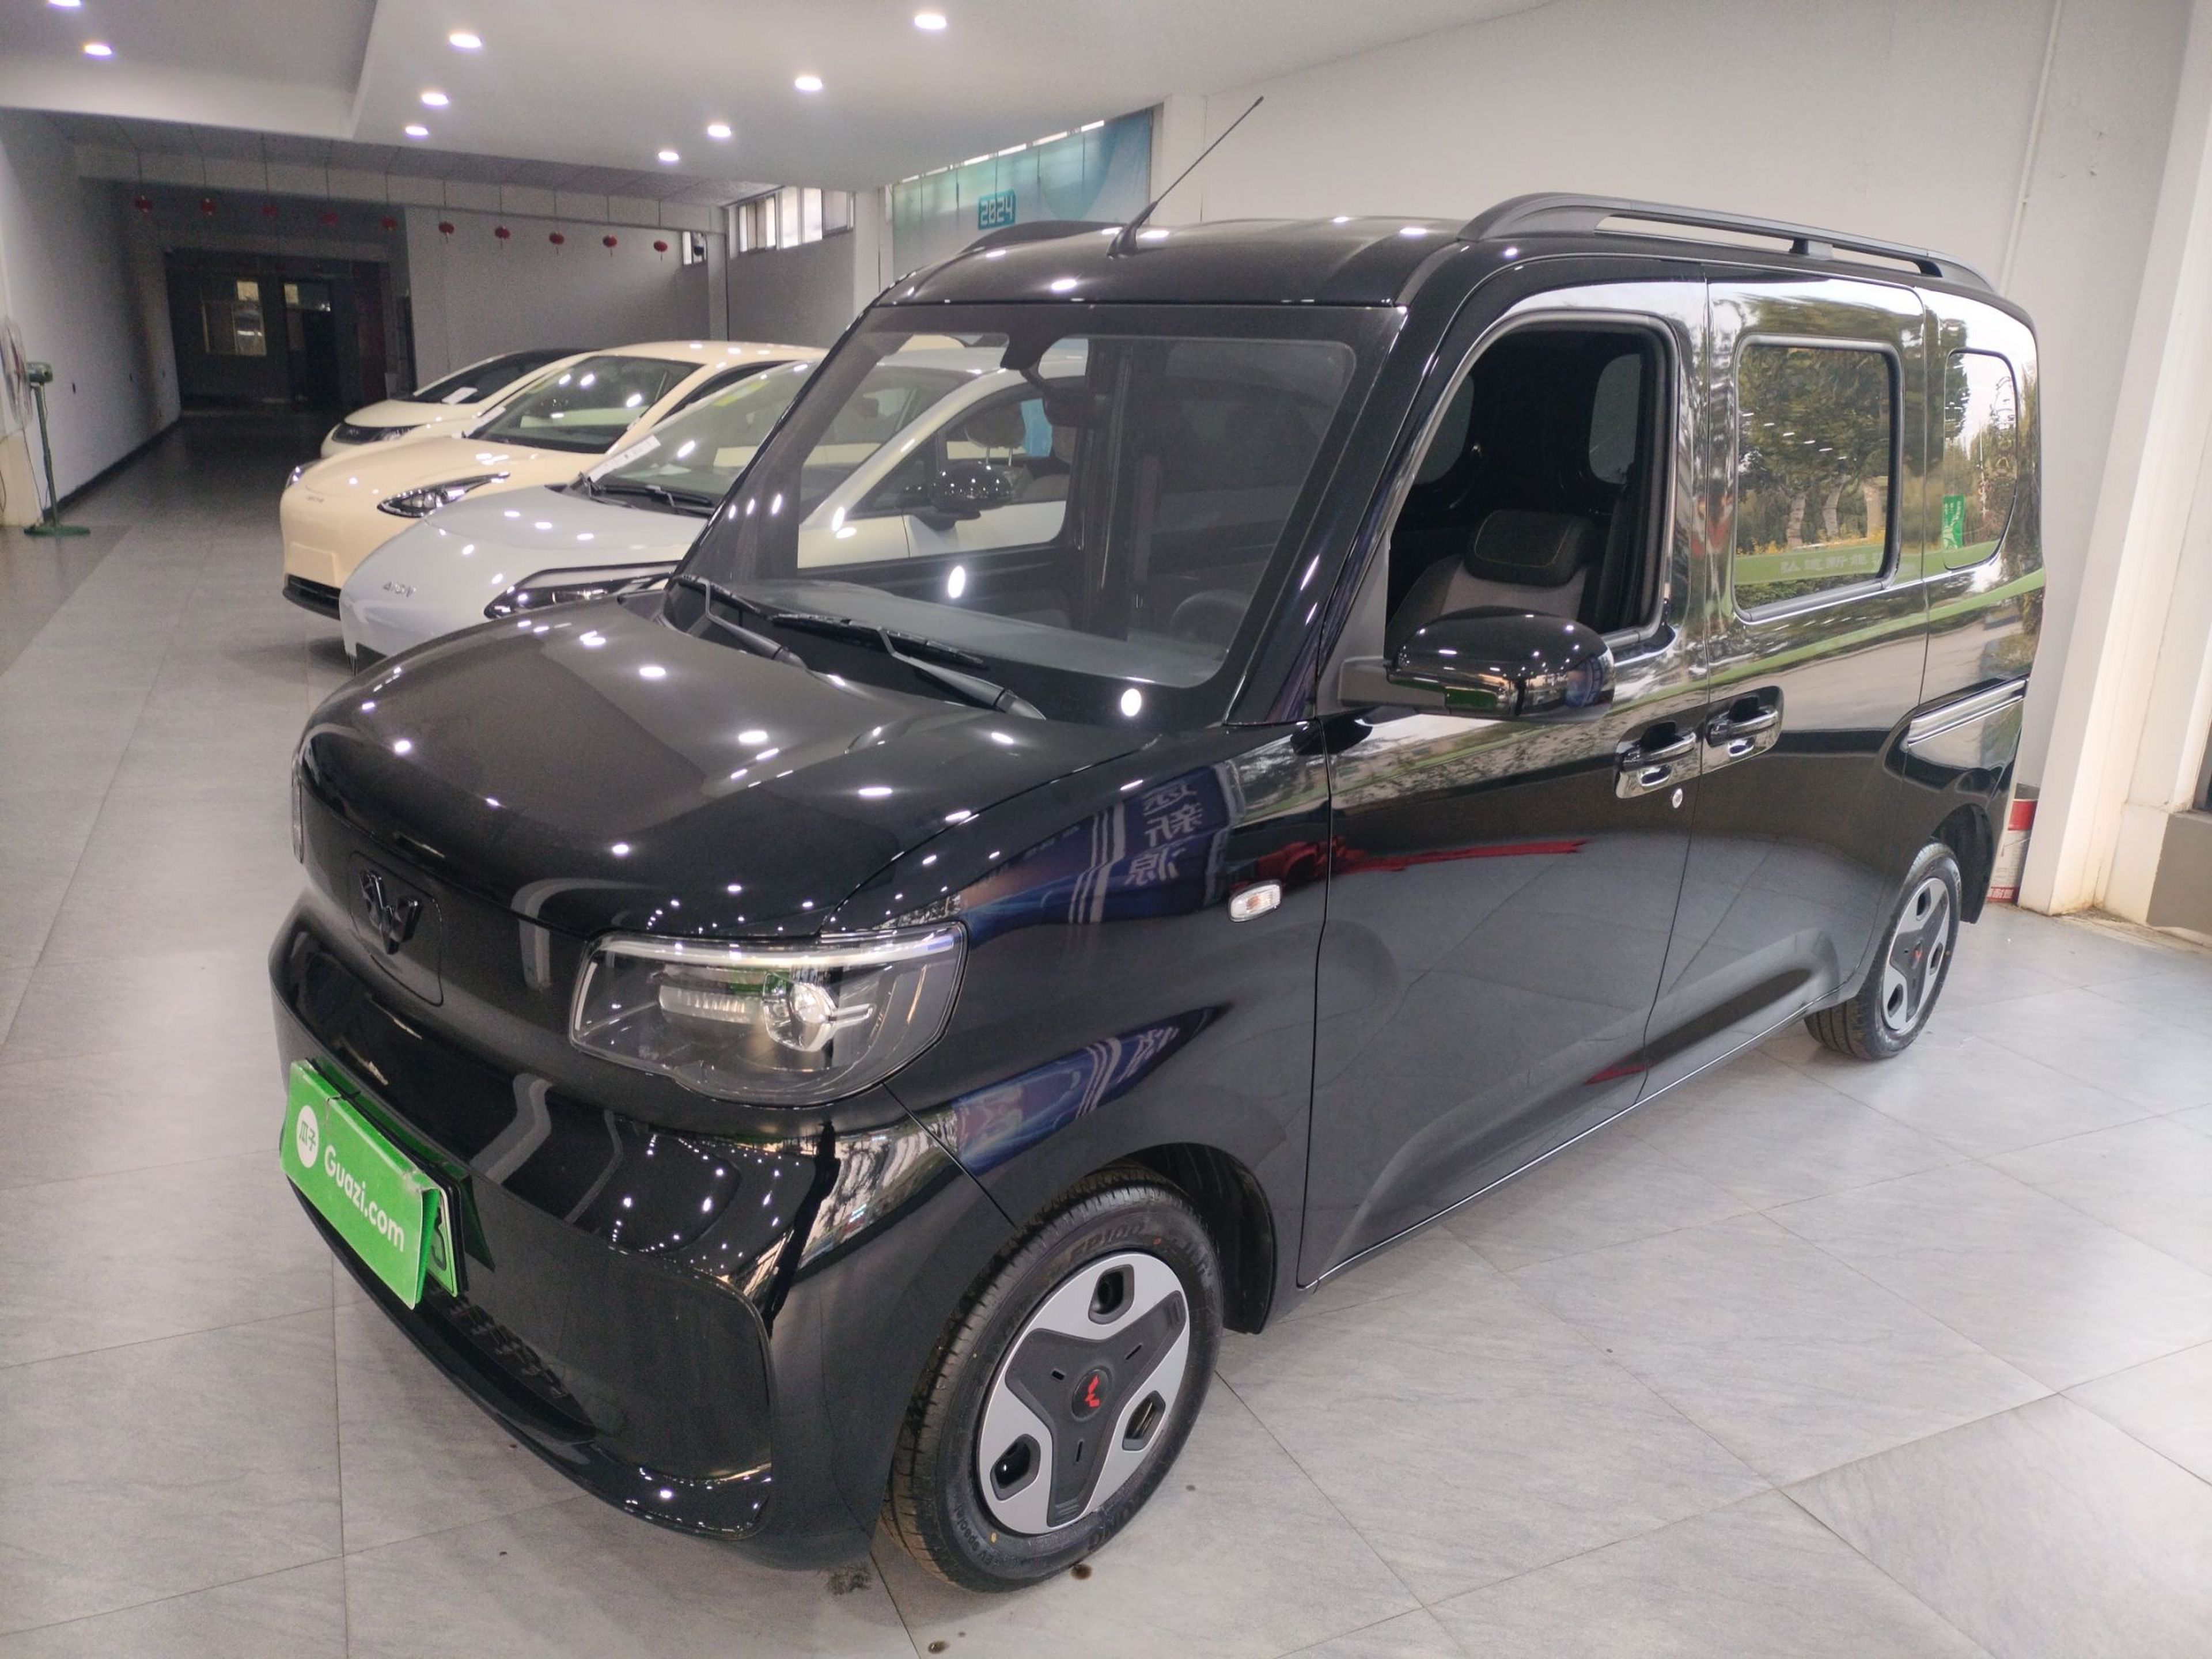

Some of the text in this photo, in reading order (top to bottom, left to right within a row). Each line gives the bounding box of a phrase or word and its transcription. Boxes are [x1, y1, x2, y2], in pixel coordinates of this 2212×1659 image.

[980, 195, 1013, 225] 2024
[299, 1121, 316, 1152] 瓜子
[324, 1145, 404, 1252] Guazi.com
